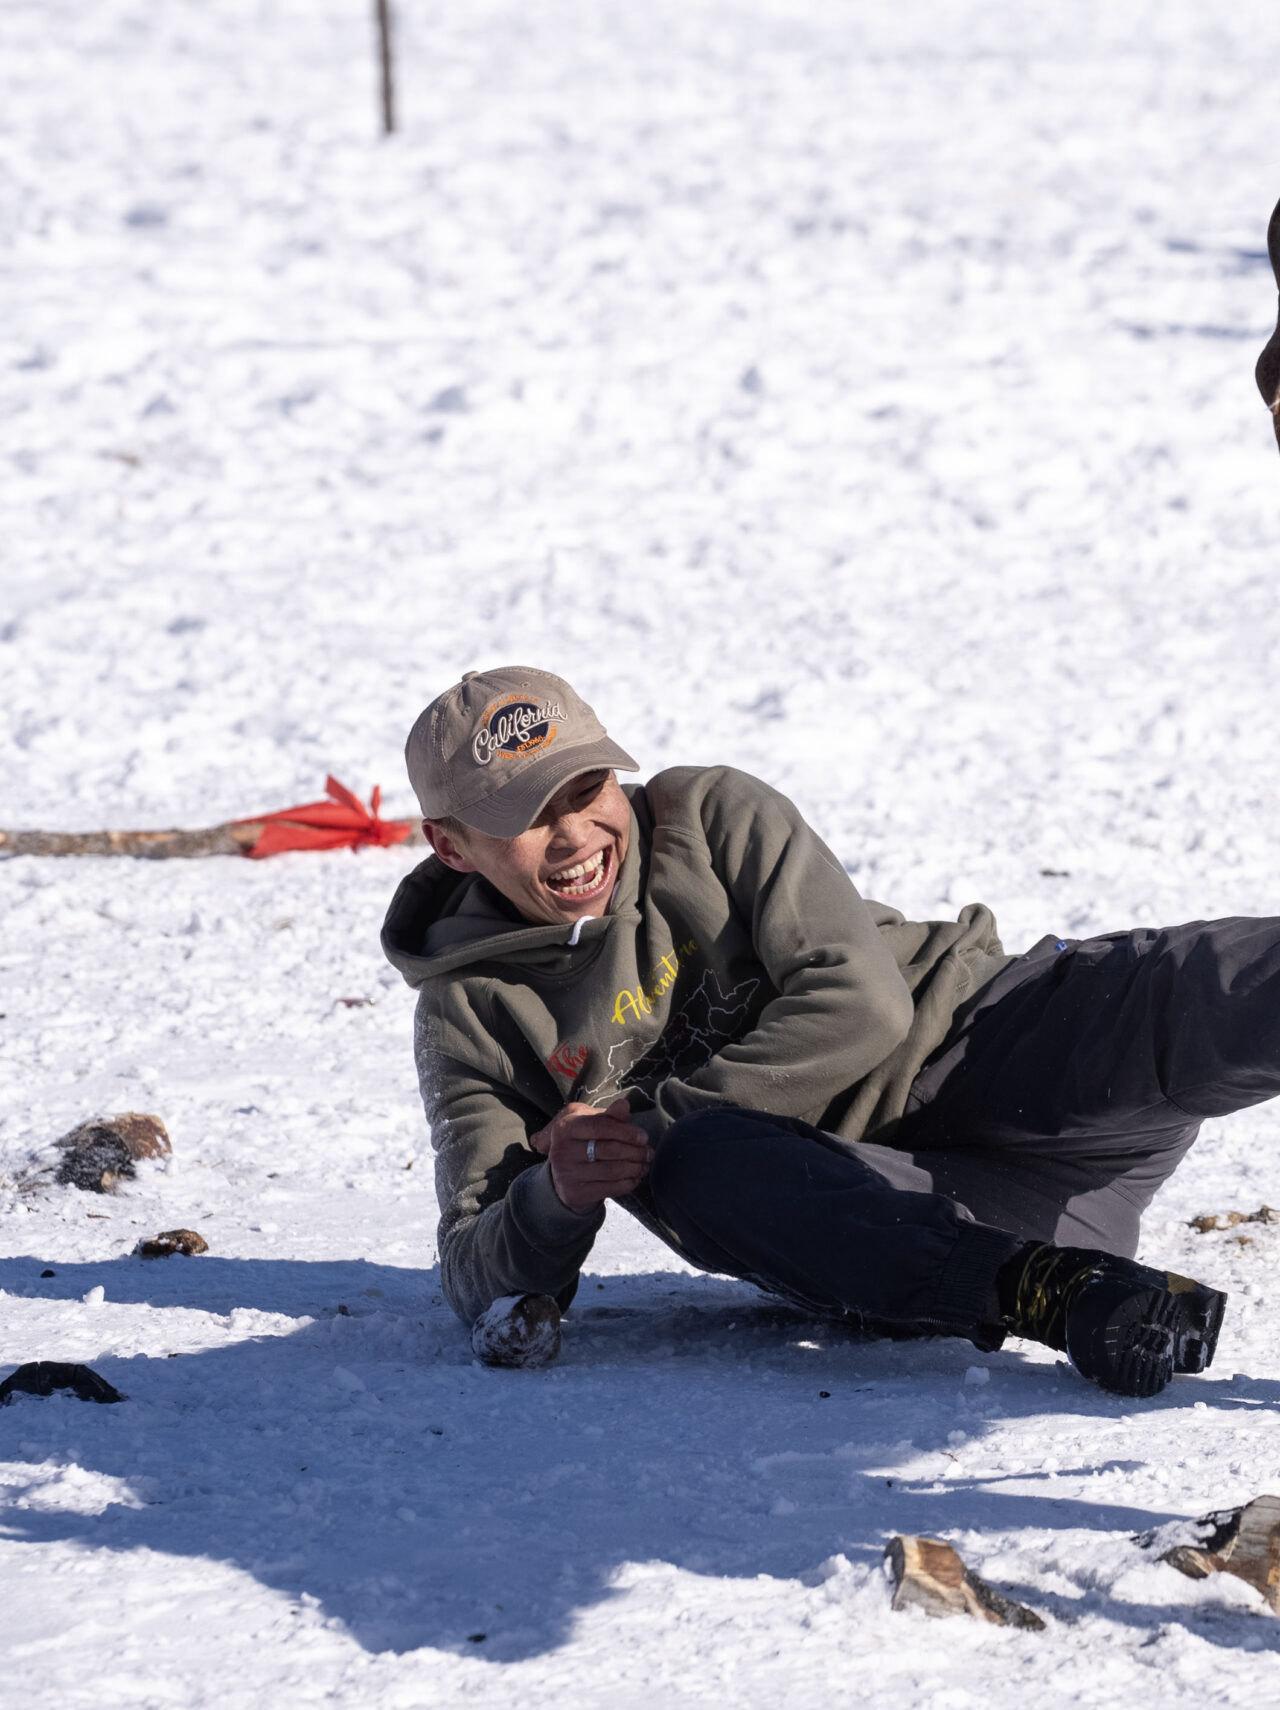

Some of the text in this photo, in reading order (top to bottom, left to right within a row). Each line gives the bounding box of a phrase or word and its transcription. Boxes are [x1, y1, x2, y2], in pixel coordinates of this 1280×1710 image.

[472, 700, 568, 765] California
[546, 939, 699, 1078] The Adventre
